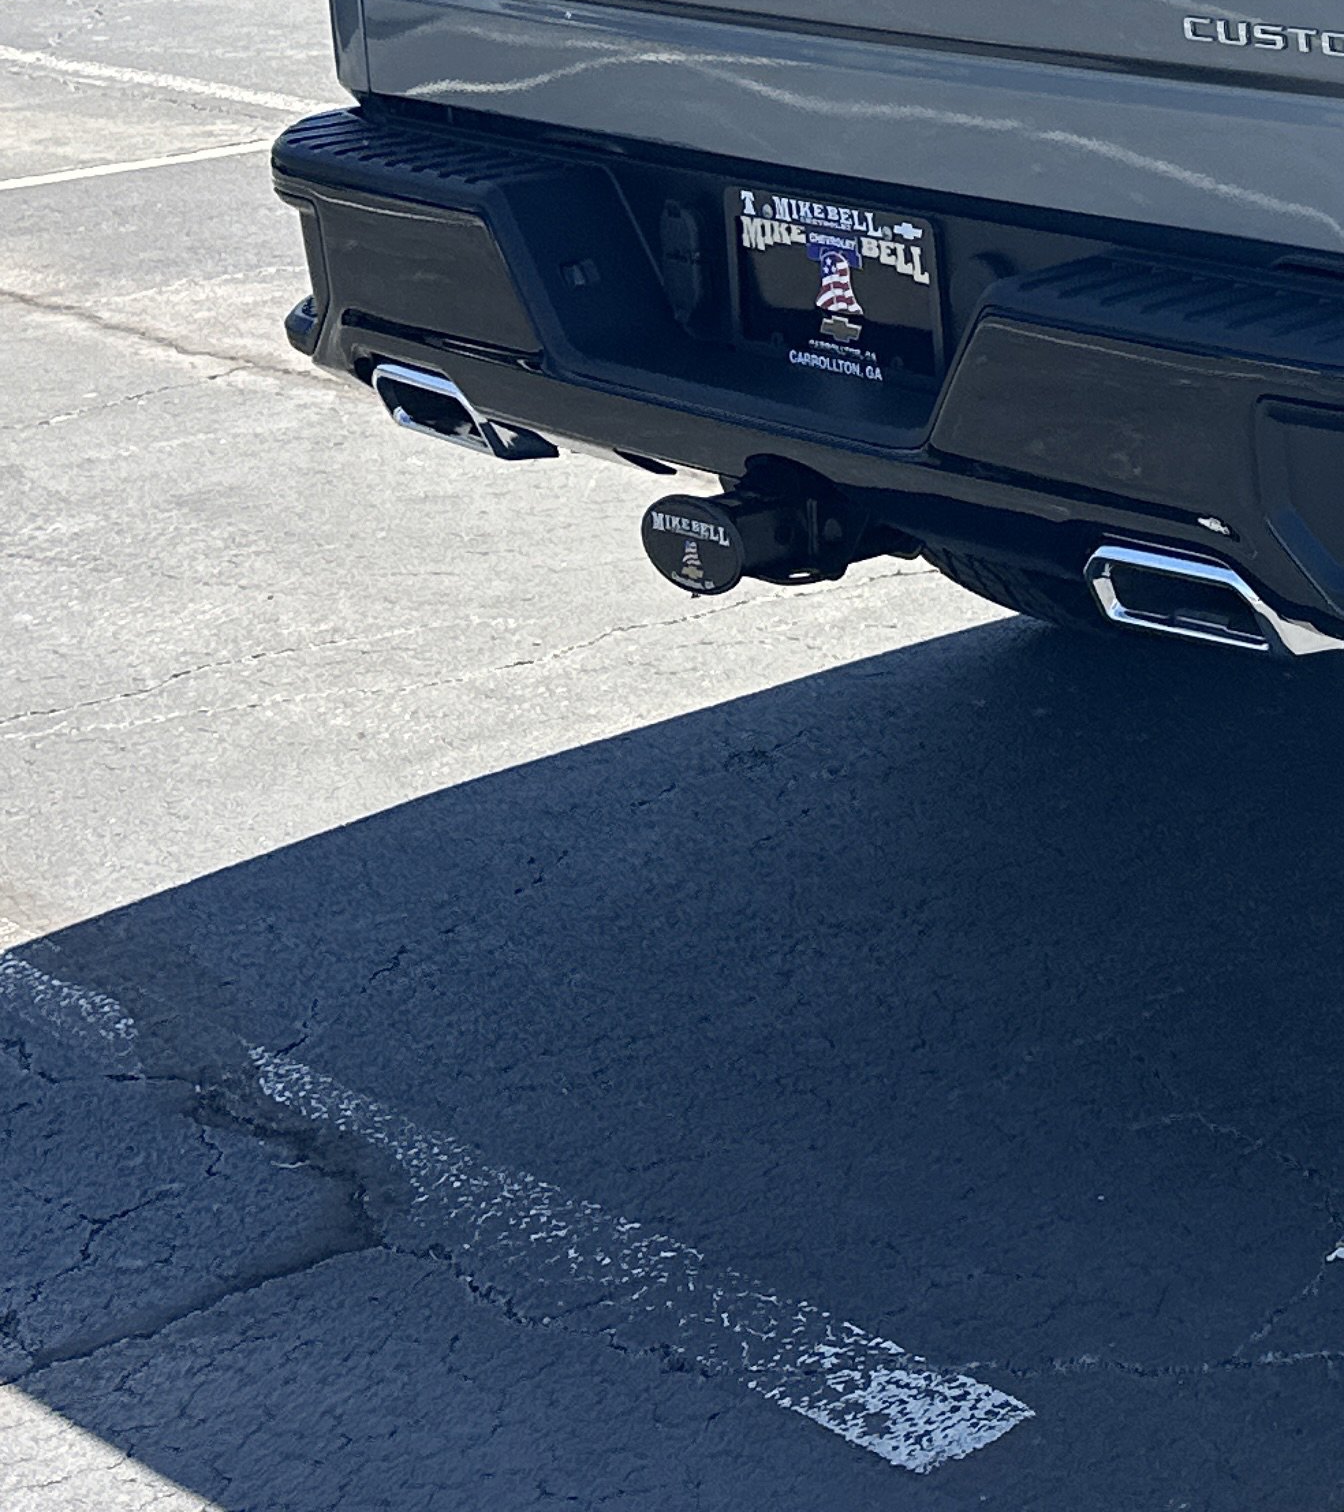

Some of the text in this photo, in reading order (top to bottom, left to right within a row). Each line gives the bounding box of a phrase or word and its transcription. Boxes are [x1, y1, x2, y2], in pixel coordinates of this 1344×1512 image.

[740, 216, 931, 285] MIKE BELL
[865, 365, 883, 381] GA
[651, 510, 691, 532] MIKE
[691, 520, 730, 547] BELL
